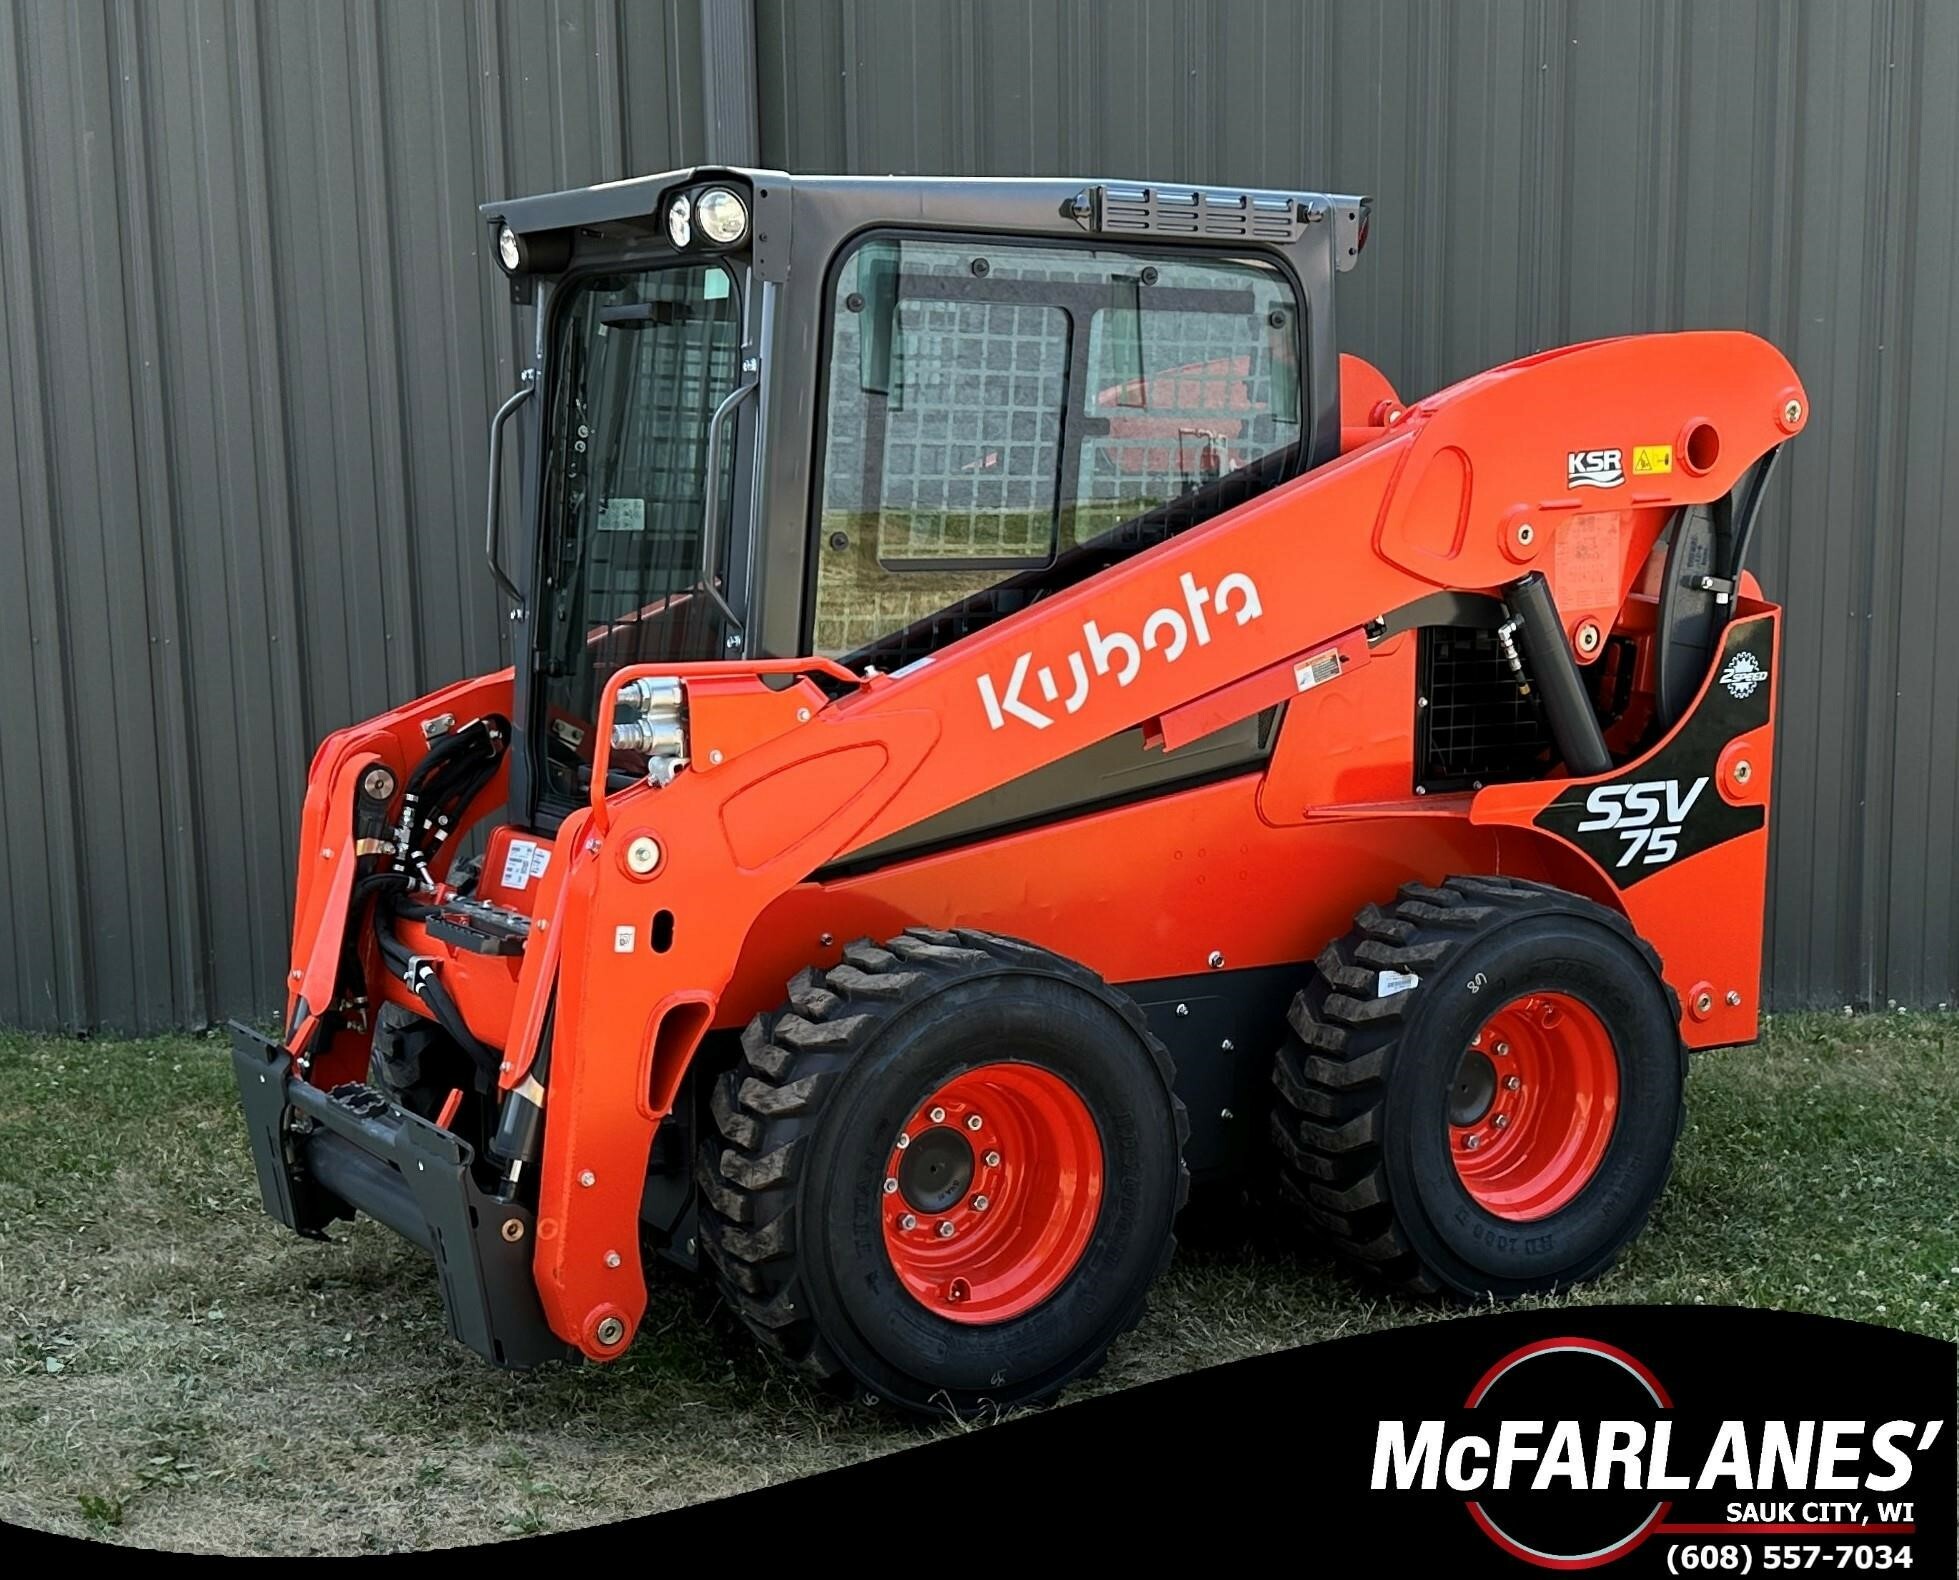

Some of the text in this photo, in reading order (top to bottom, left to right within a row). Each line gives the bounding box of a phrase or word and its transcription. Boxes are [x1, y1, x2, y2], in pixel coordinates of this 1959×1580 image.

[1568, 449, 1622, 474] KSR
[976, 571, 1263, 731] Kubota
[1577, 776, 1710, 832] SSV
[1615, 825, 1682, 867] 75
